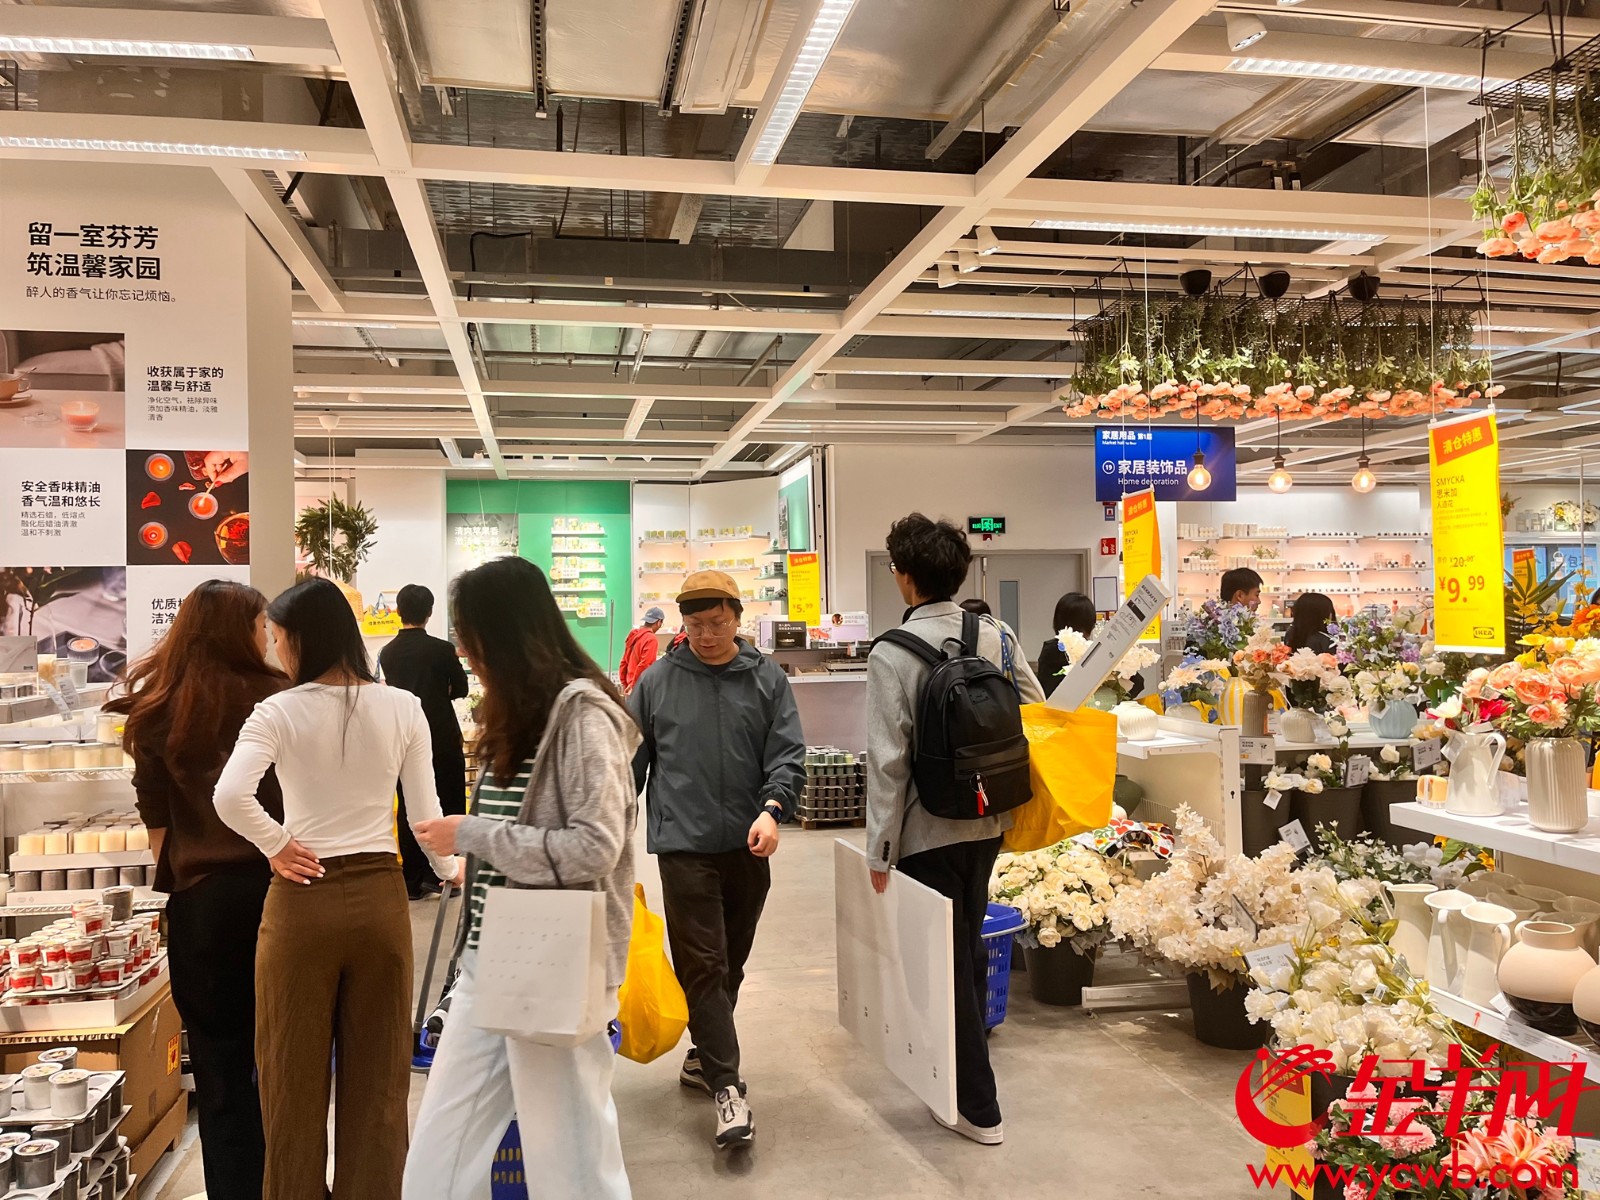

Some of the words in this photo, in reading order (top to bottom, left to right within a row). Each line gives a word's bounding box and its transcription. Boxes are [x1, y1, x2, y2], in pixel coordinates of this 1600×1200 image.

[28, 221, 159, 250] 留一室芬芳
[27, 251, 161, 280] 筑温馨家园
[26, 285, 177, 303] 醉人的香气让你忘记烦恼。
[147, 366, 224, 378] 收获属于家的
[147, 380, 212, 392] 温馨与舒适
[1102, 431, 1136, 440] 家居用品
[1443, 427, 1483, 454] 清仓特惠
[1118, 460, 1188, 475] 家居装饰品
[21, 480, 101, 493] 安全香味精油
[1141, 477, 1179, 485] decoration
[1436, 474, 1465, 487] SMYCKA
[21, 495, 101, 507] 香气温和悠长
